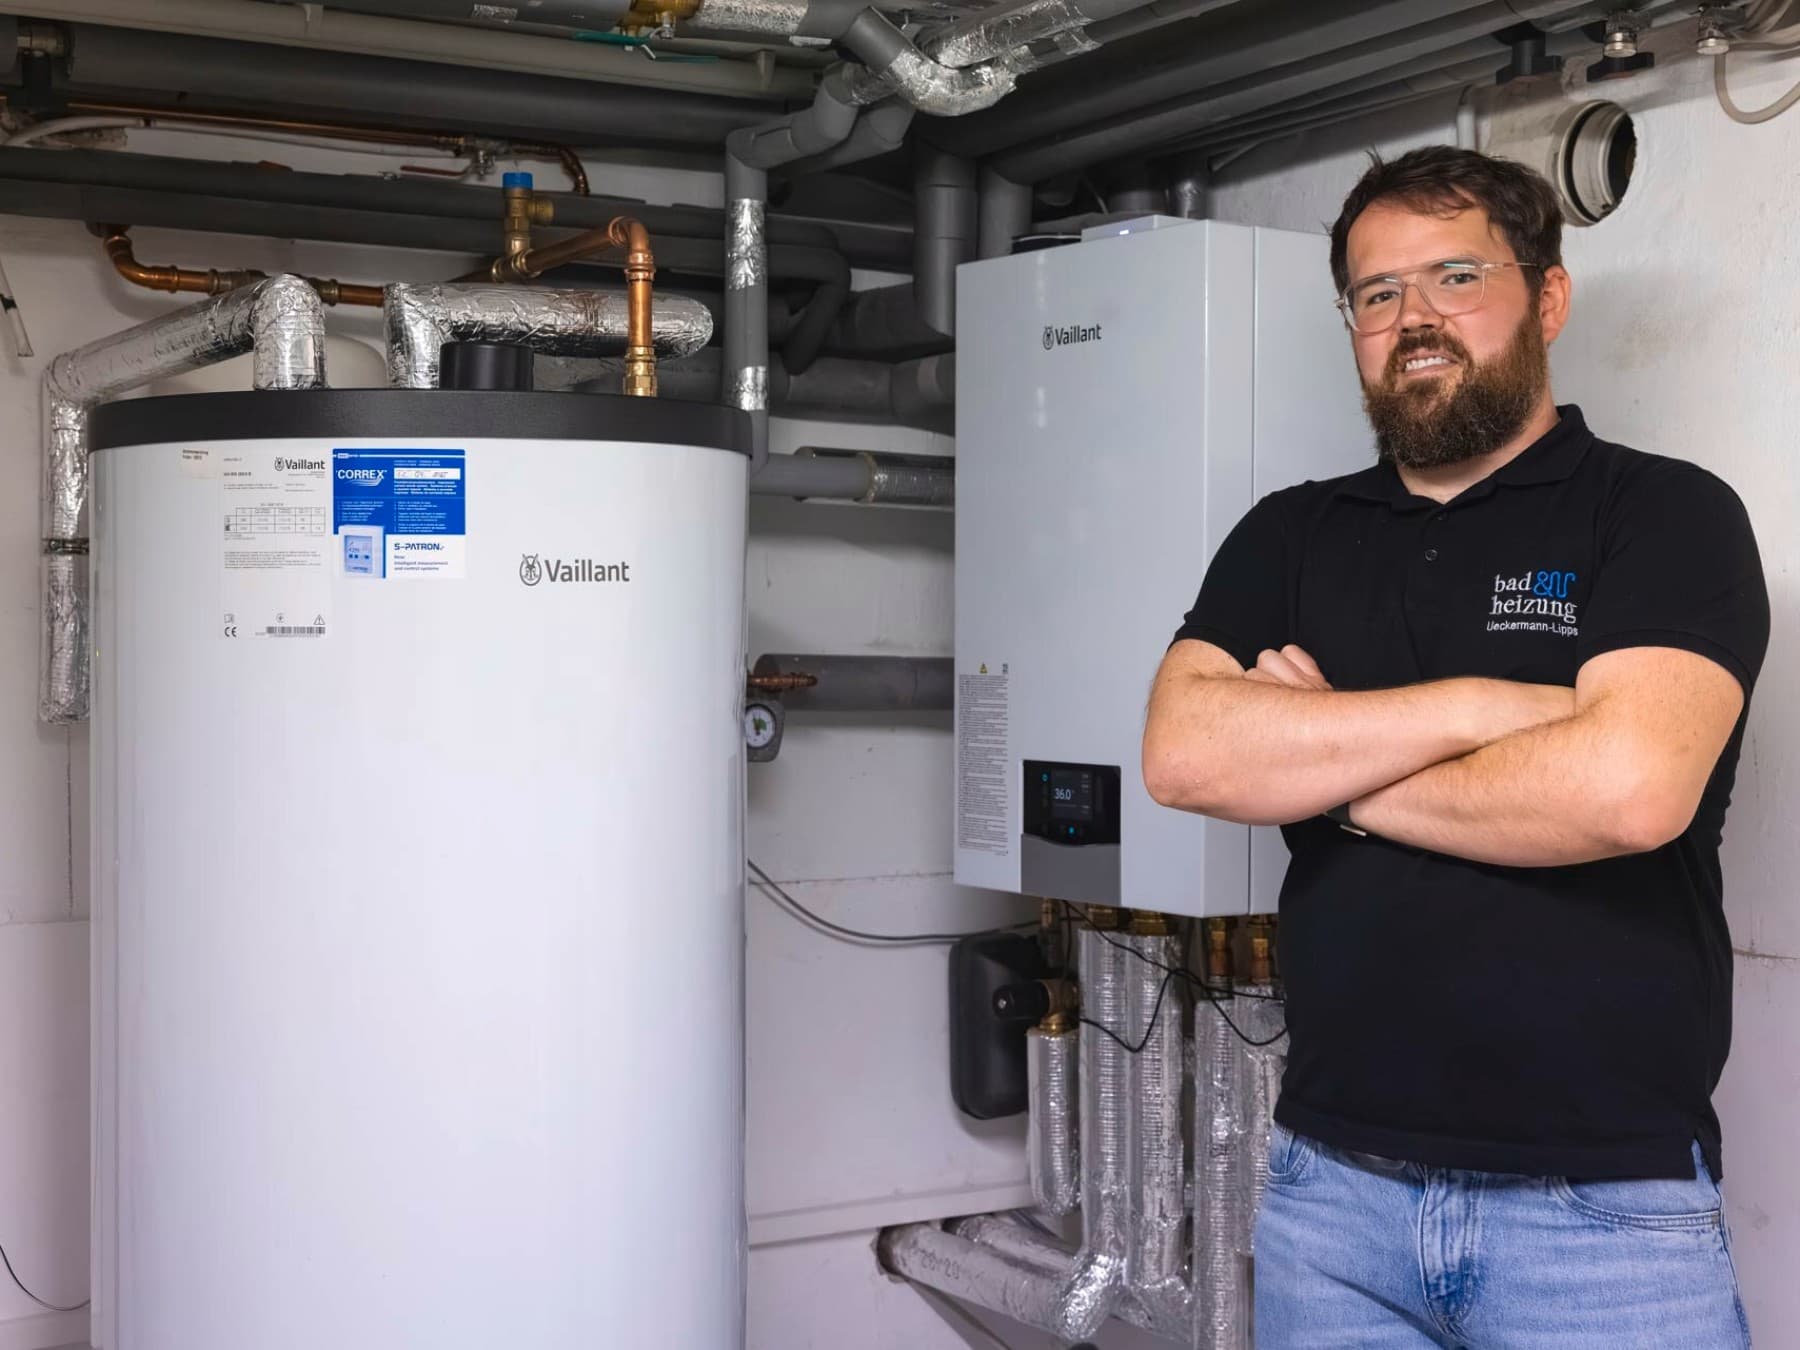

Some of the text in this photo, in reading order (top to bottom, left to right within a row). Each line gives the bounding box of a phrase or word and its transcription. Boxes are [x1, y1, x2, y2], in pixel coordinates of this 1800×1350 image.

[1055, 323, 1102, 346] Vaillant
[285, 459, 325, 470] Vaillant
[337, 469, 384, 479] CORREX
[394, 542, 440, 551] S-PATRON
[544, 559, 630, 582] Vaillant
[1494, 571, 1532, 593] bad
[1489, 595, 1578, 624] heizung
[1486, 620, 1579, 637] Ueckermann-Lipps
